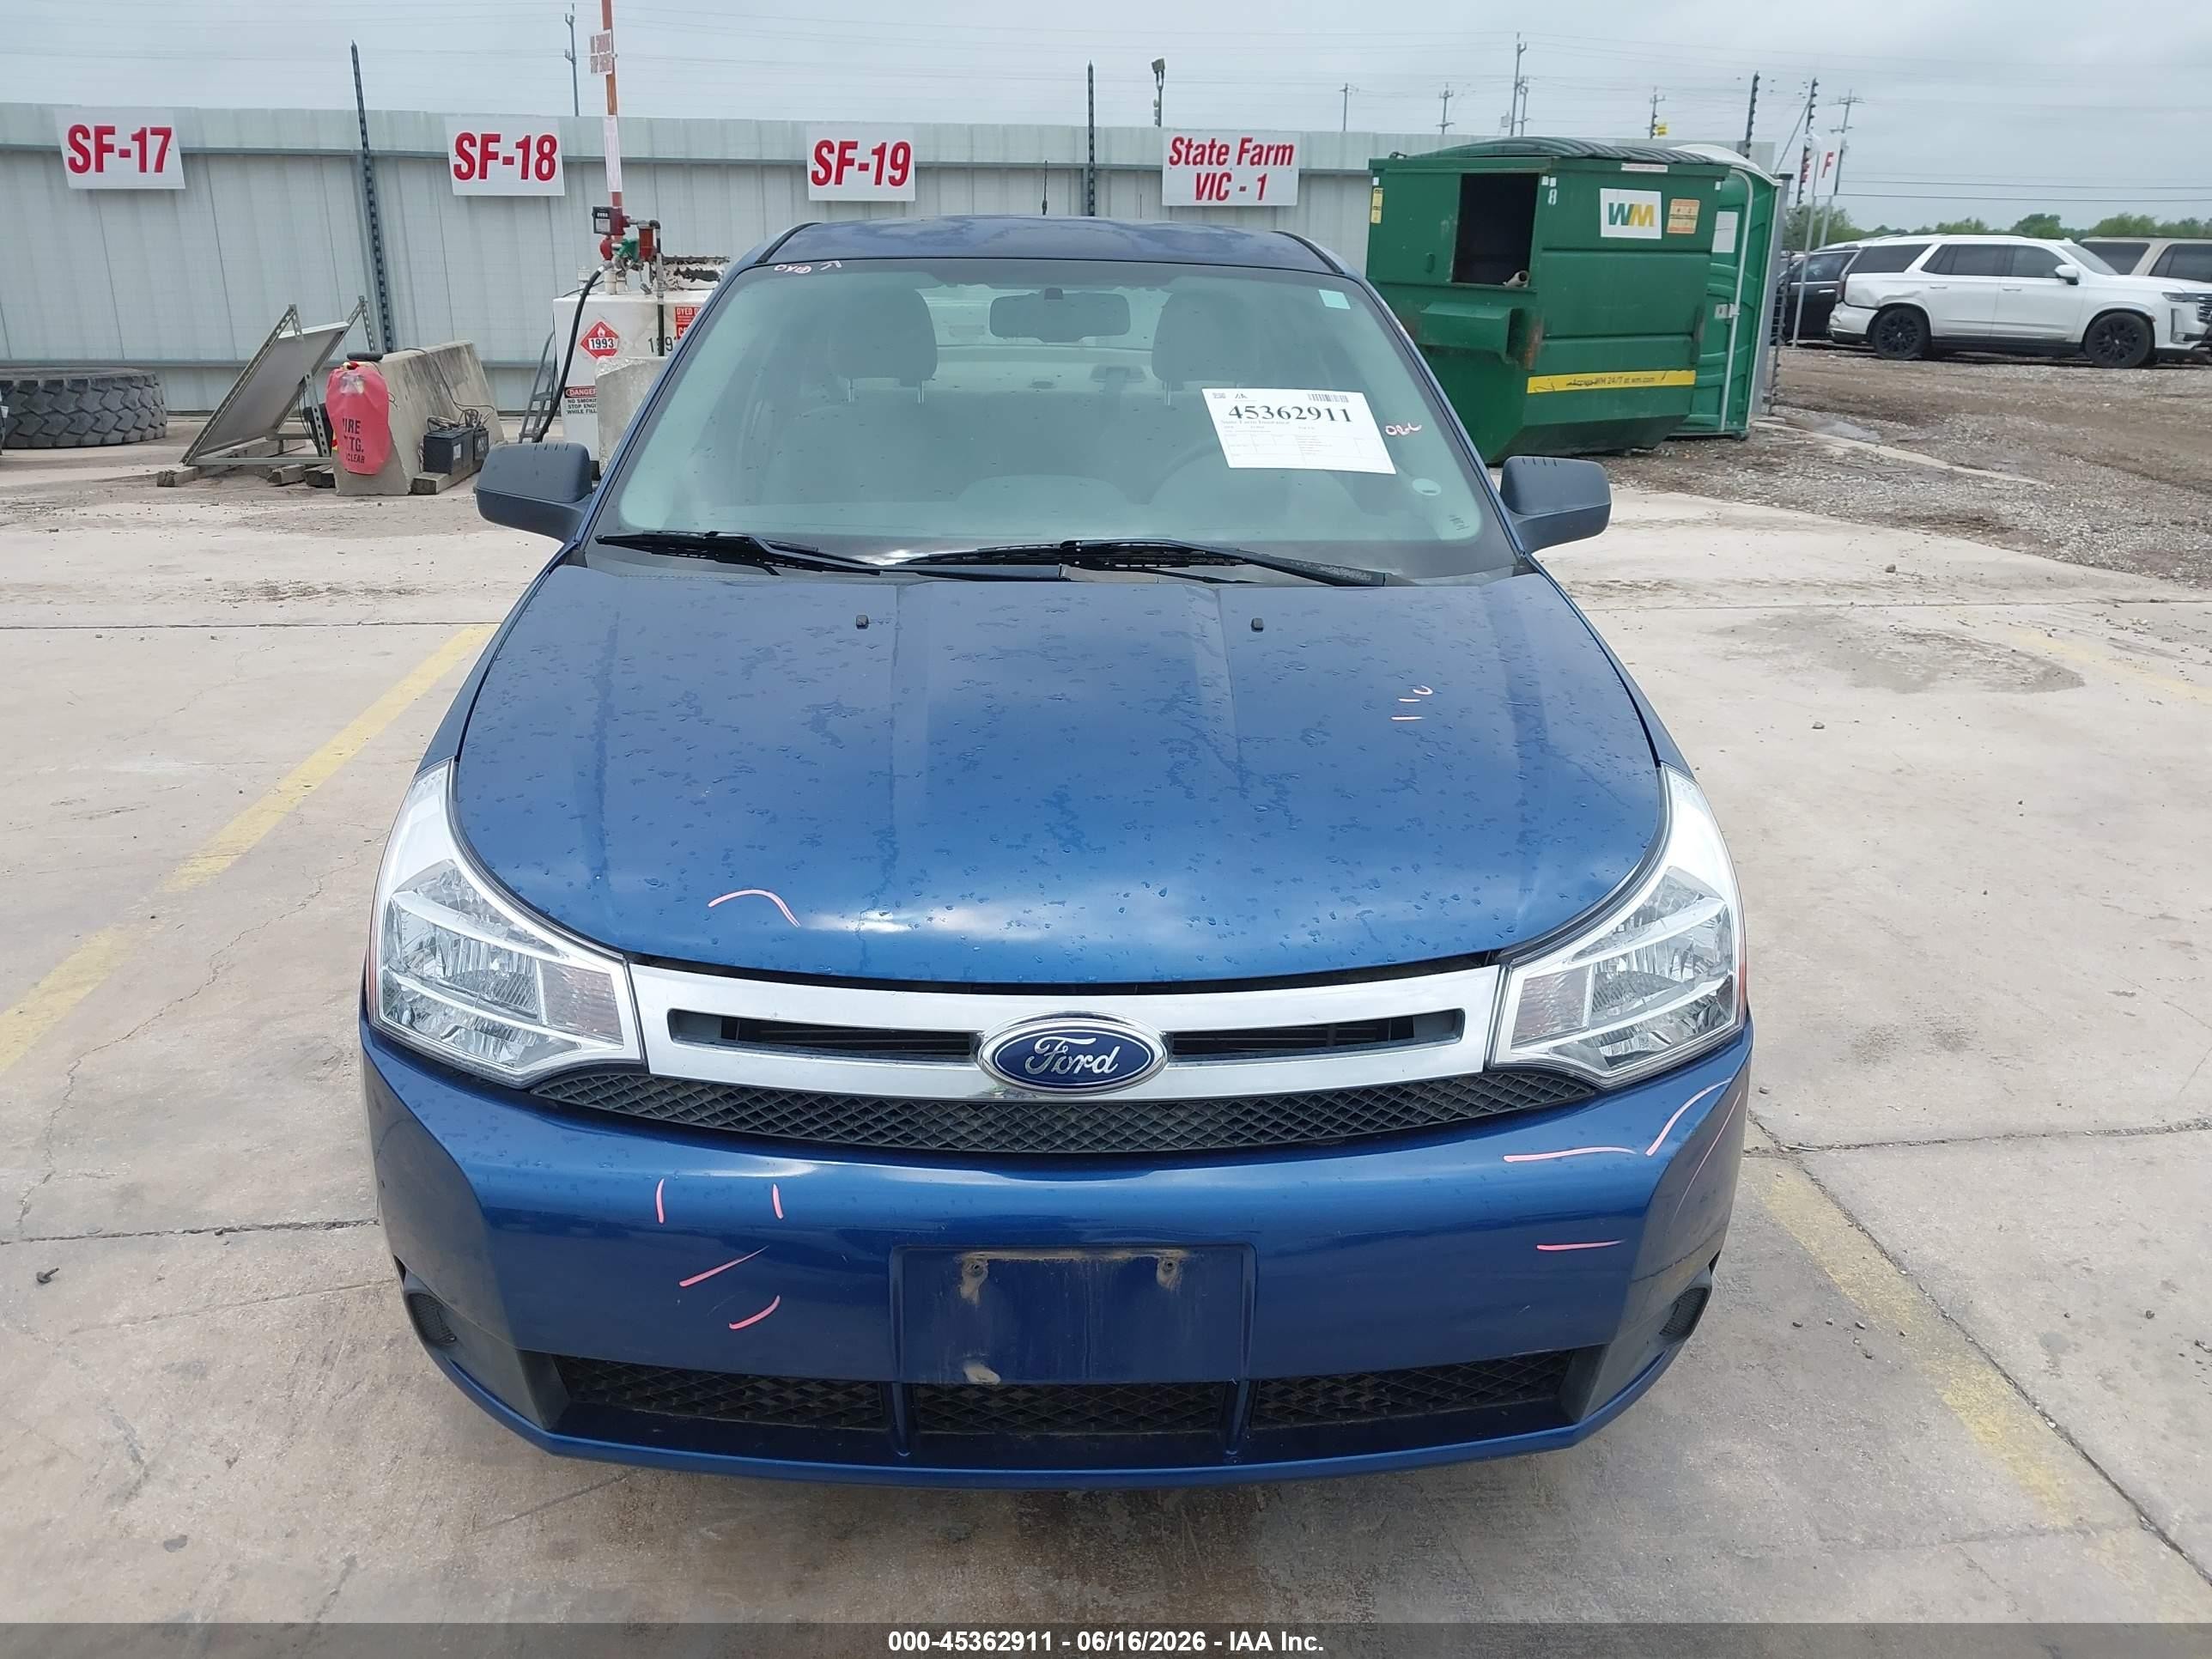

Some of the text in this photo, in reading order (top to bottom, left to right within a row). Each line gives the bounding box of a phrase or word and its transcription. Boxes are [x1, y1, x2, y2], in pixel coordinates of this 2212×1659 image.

[68, 124, 172, 174] SF-17
[453, 131, 558, 181] SF-18
[811, 139, 912, 186] SF-19
[1169, 137, 1295, 166] State Farm
[1821, 151, 1834, 178] F
[1194, 172, 1232, 201] VIC
[1256, 173, 1267, 201] 1
[1547, 188, 1558, 205] 8
[1608, 202, 1655, 227] WM
[590, 338, 614, 349] 1993
[1228, 404, 1352, 422] 45362911
[1024, 1036, 1121, 1074] Ford
